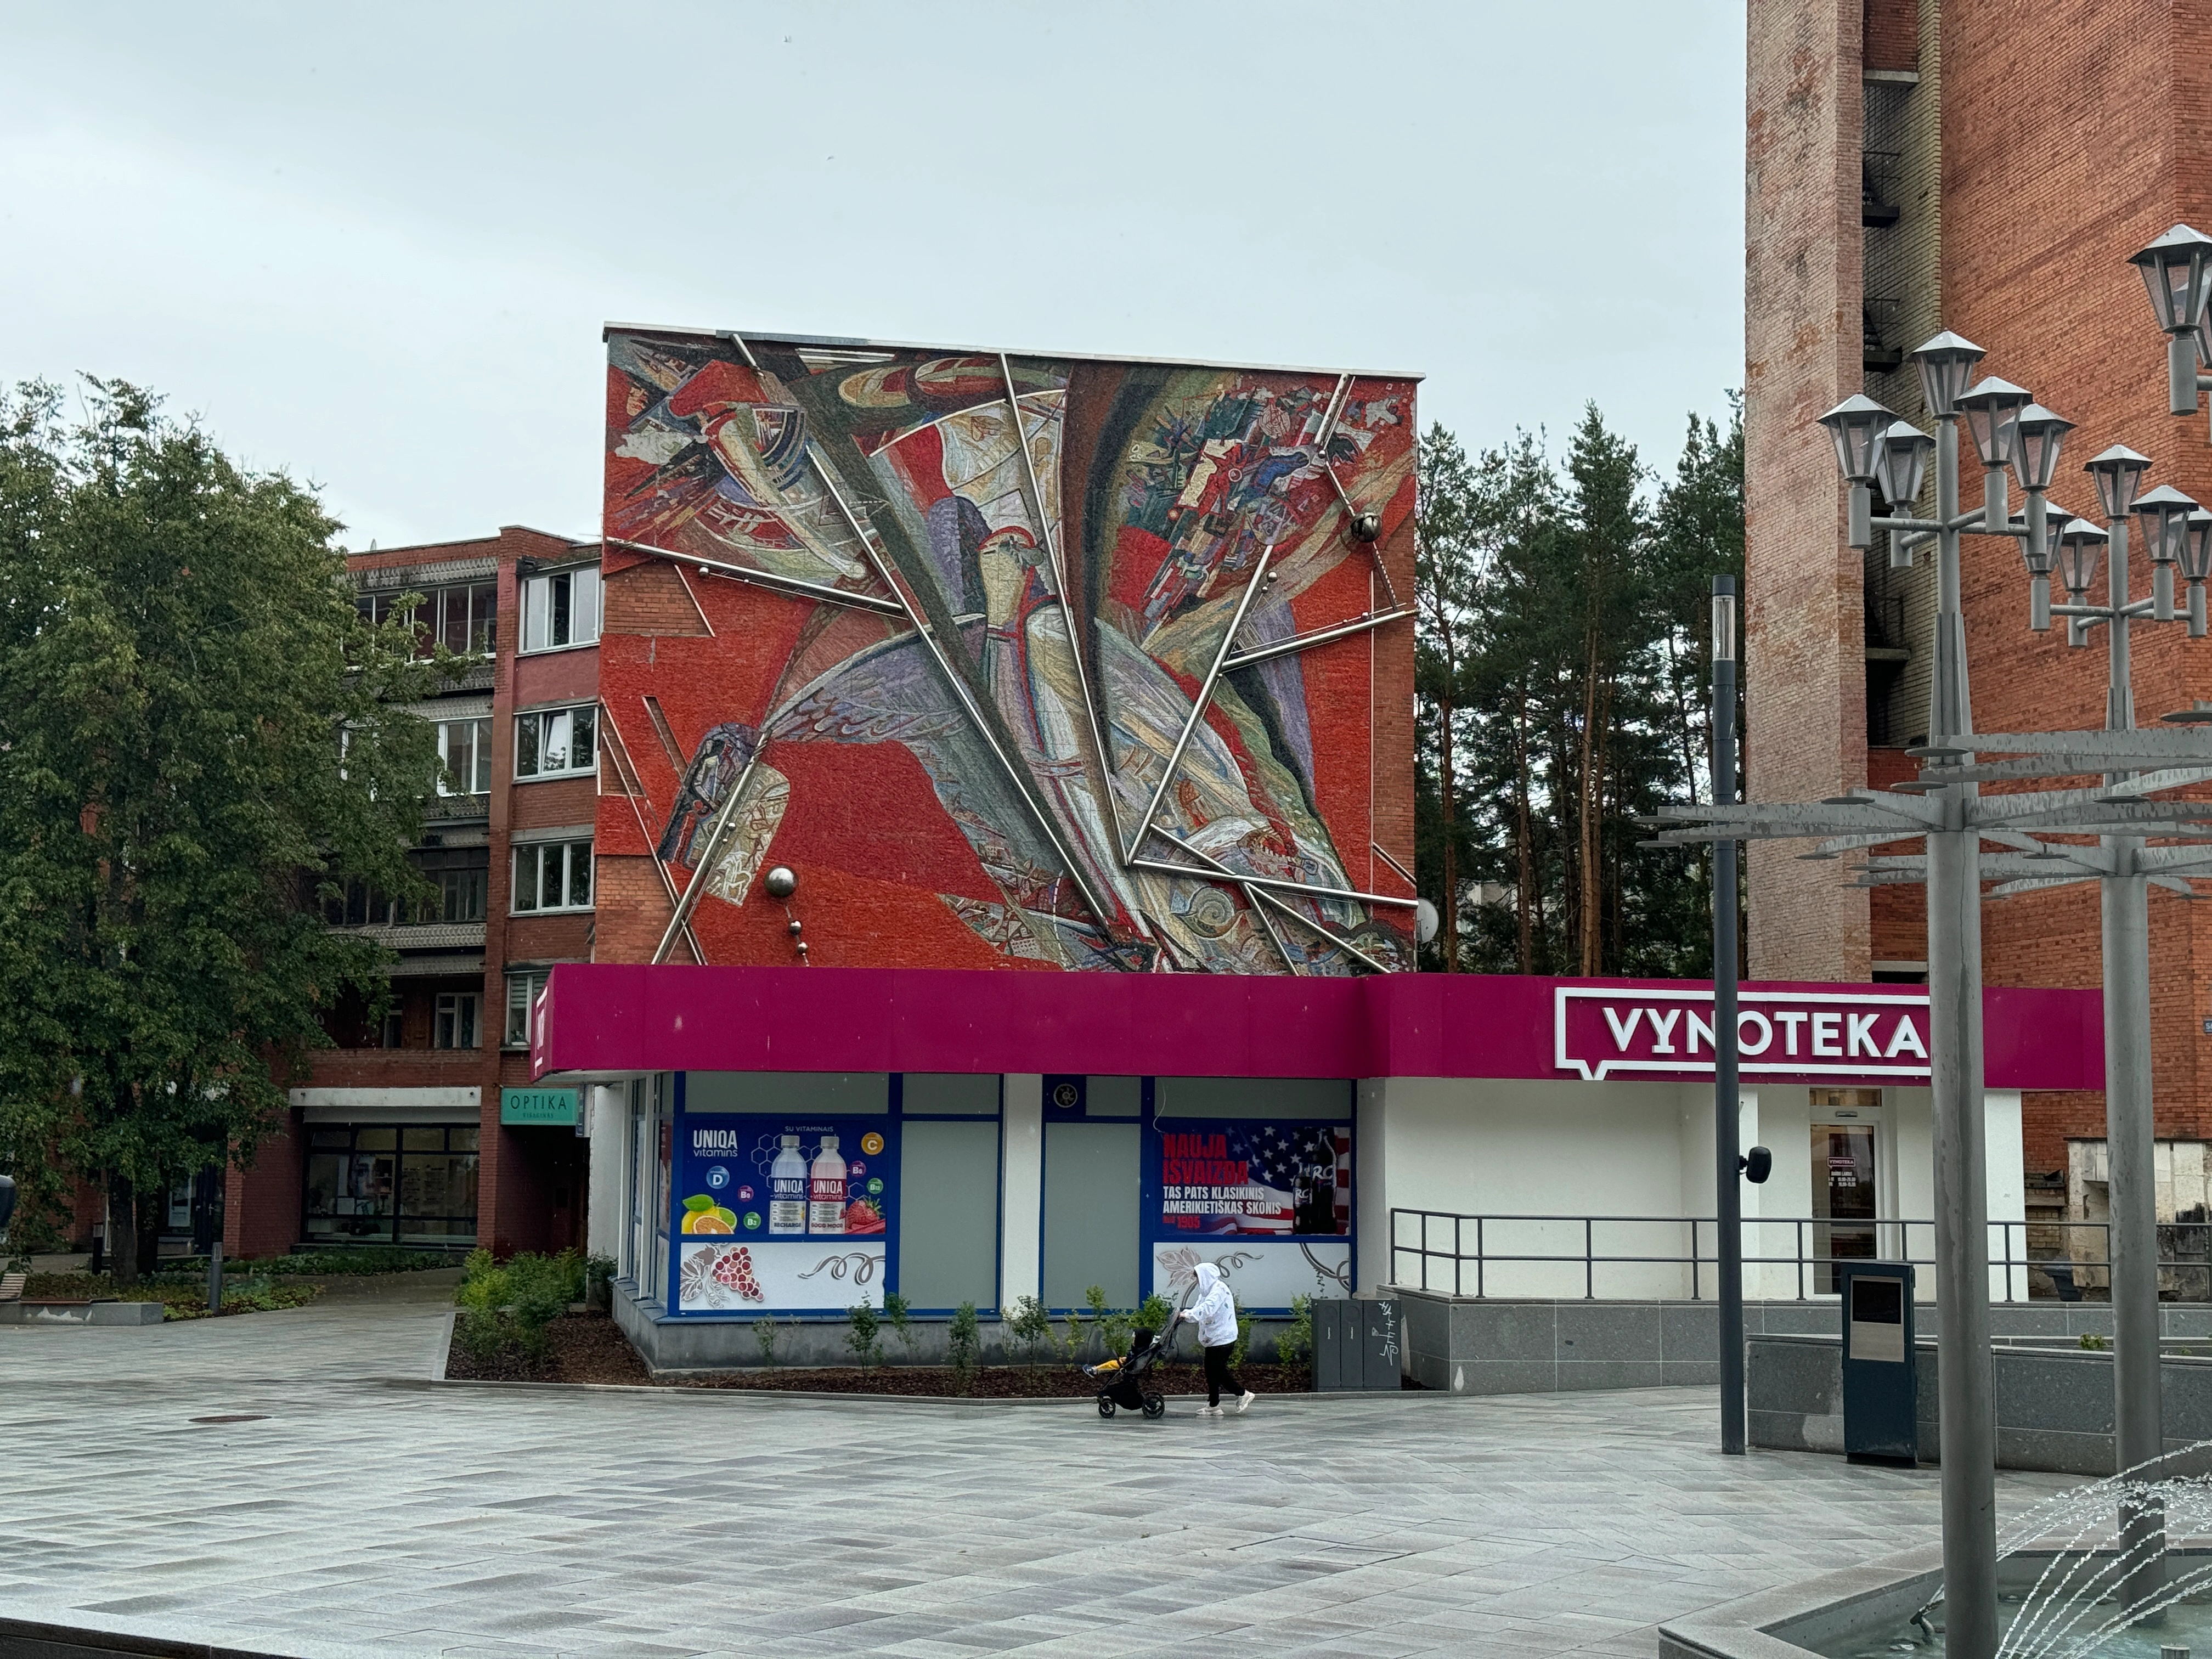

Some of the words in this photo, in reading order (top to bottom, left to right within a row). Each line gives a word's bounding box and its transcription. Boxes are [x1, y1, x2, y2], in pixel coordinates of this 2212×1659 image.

[1602, 1006, 1928, 1059] VYNOTEKA
[511, 1096, 567, 1110] OPTIKA
[693, 1128, 738, 1149] UNIQA
[867, 1140, 878, 1150] C
[1163, 1133, 1227, 1159] NAUJA
[1163, 1158, 1249, 1185] IŠVAIZDA
[1312, 1165, 1333, 1181] RC
[713, 1174, 723, 1186] D
[774, 1180, 804, 1193] UNIQA
[813, 1180, 843, 1194] UNIQA
[1163, 1186, 1181, 1199] TAS
[1184, 1186, 1209, 1199] PATS
[1211, 1187, 1264, 1200] KLASIKINIS
[1295, 1189, 1309, 1199] RC
[1163, 1200, 1243, 1214] AMERIKIETIŠKAS
[1246, 1201, 1282, 1215] SKONIS
